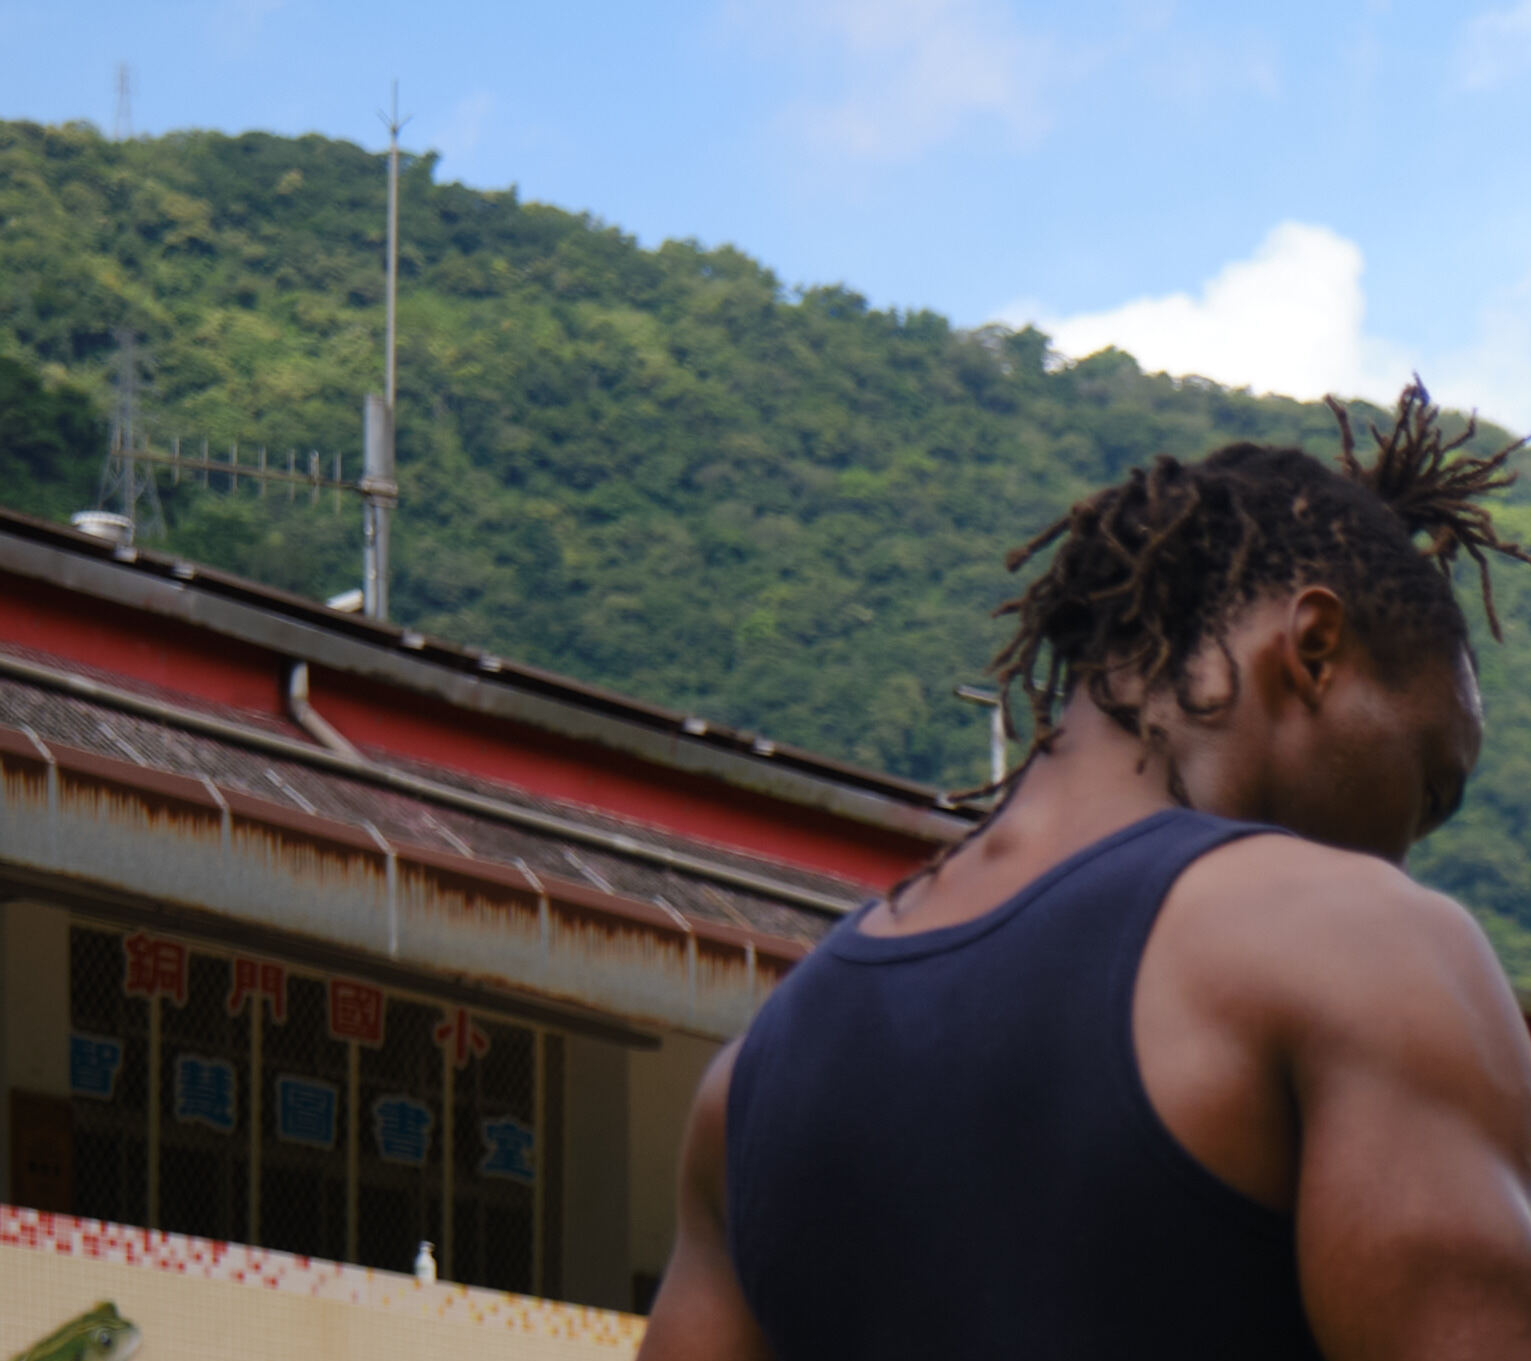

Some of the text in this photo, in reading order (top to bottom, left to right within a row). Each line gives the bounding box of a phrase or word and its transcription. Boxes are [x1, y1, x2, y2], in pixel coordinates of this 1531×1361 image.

[124, 931, 492, 1067] 銅門國小
[69, 1032, 537, 1184] 智慧圖書室
